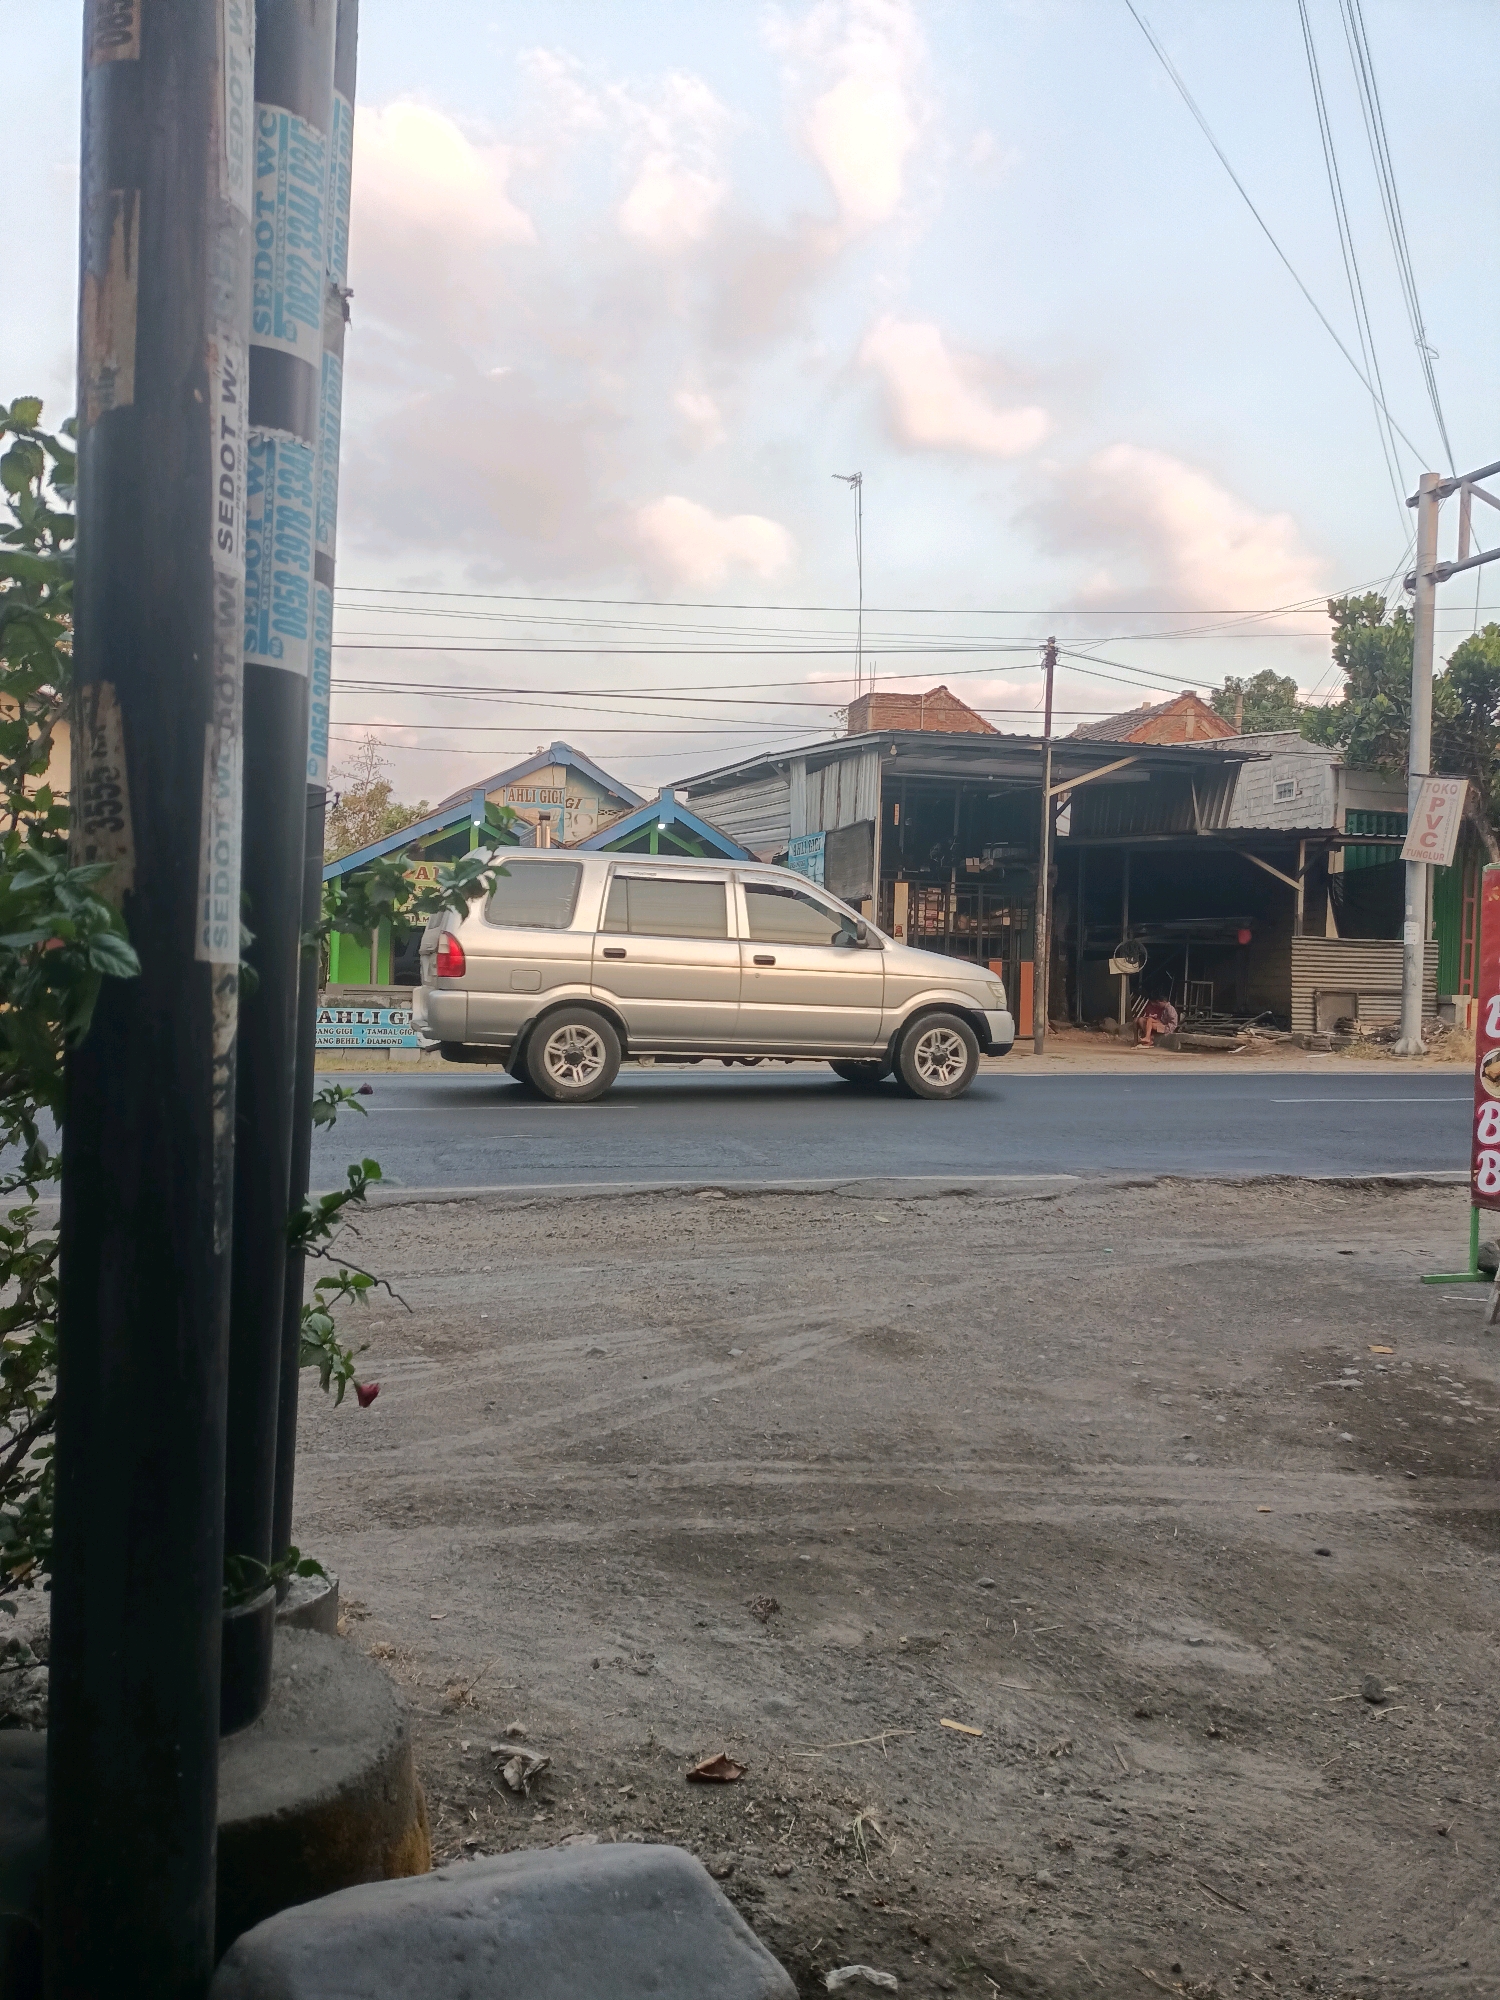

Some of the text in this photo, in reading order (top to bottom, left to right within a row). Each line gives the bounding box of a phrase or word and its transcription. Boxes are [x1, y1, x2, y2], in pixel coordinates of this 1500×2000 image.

[229, 45, 244, 189] SEDOT
[253, 110, 277, 336] SEDOT WC
[275, 204, 285, 292] DISKON
[286, 183, 323, 263] 3344
[284, 254, 321, 330] 0822
[217, 415, 236, 555] SEDOT
[261, 467, 275, 611] DISKON 10%
[273, 504, 312, 573] 3978
[244, 509, 263, 655] SEDOT
[270, 570, 309, 640] 0858
[508, 788, 563, 804] AHLI GIGI
[1425, 783, 1458, 795] TOKO
[213, 817, 231, 950] SEDOT
[1406, 849, 1445, 861] TUNGLUR
[317, 1010, 381, 1024] AHLI
[367, 1028, 397, 1036] TAMBAL
